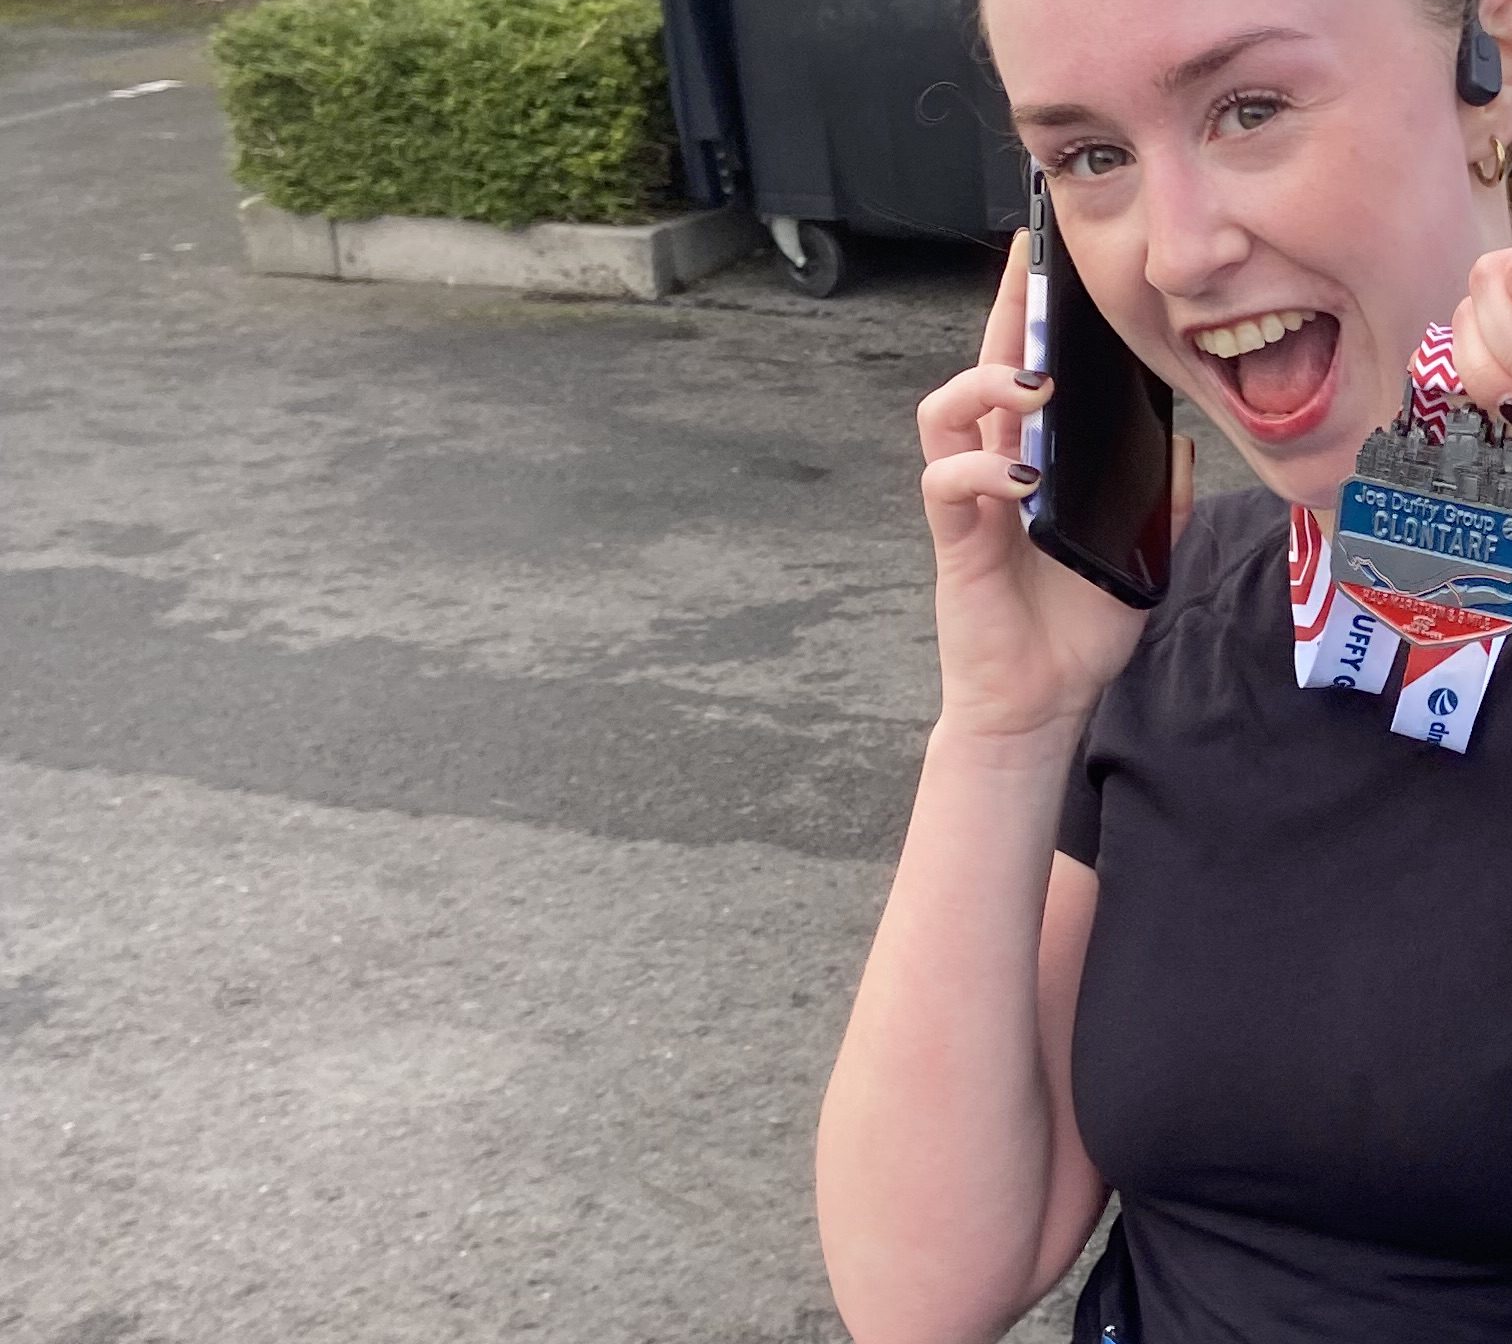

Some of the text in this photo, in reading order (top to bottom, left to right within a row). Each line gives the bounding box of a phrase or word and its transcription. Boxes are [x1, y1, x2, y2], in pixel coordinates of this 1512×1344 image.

[1373, 510, 1498, 562] CLONTARF
[1391, 492, 1440, 522] Duffy
[1444, 504, 1495, 535] Group
[1340, 614, 1376, 672] UFFY
